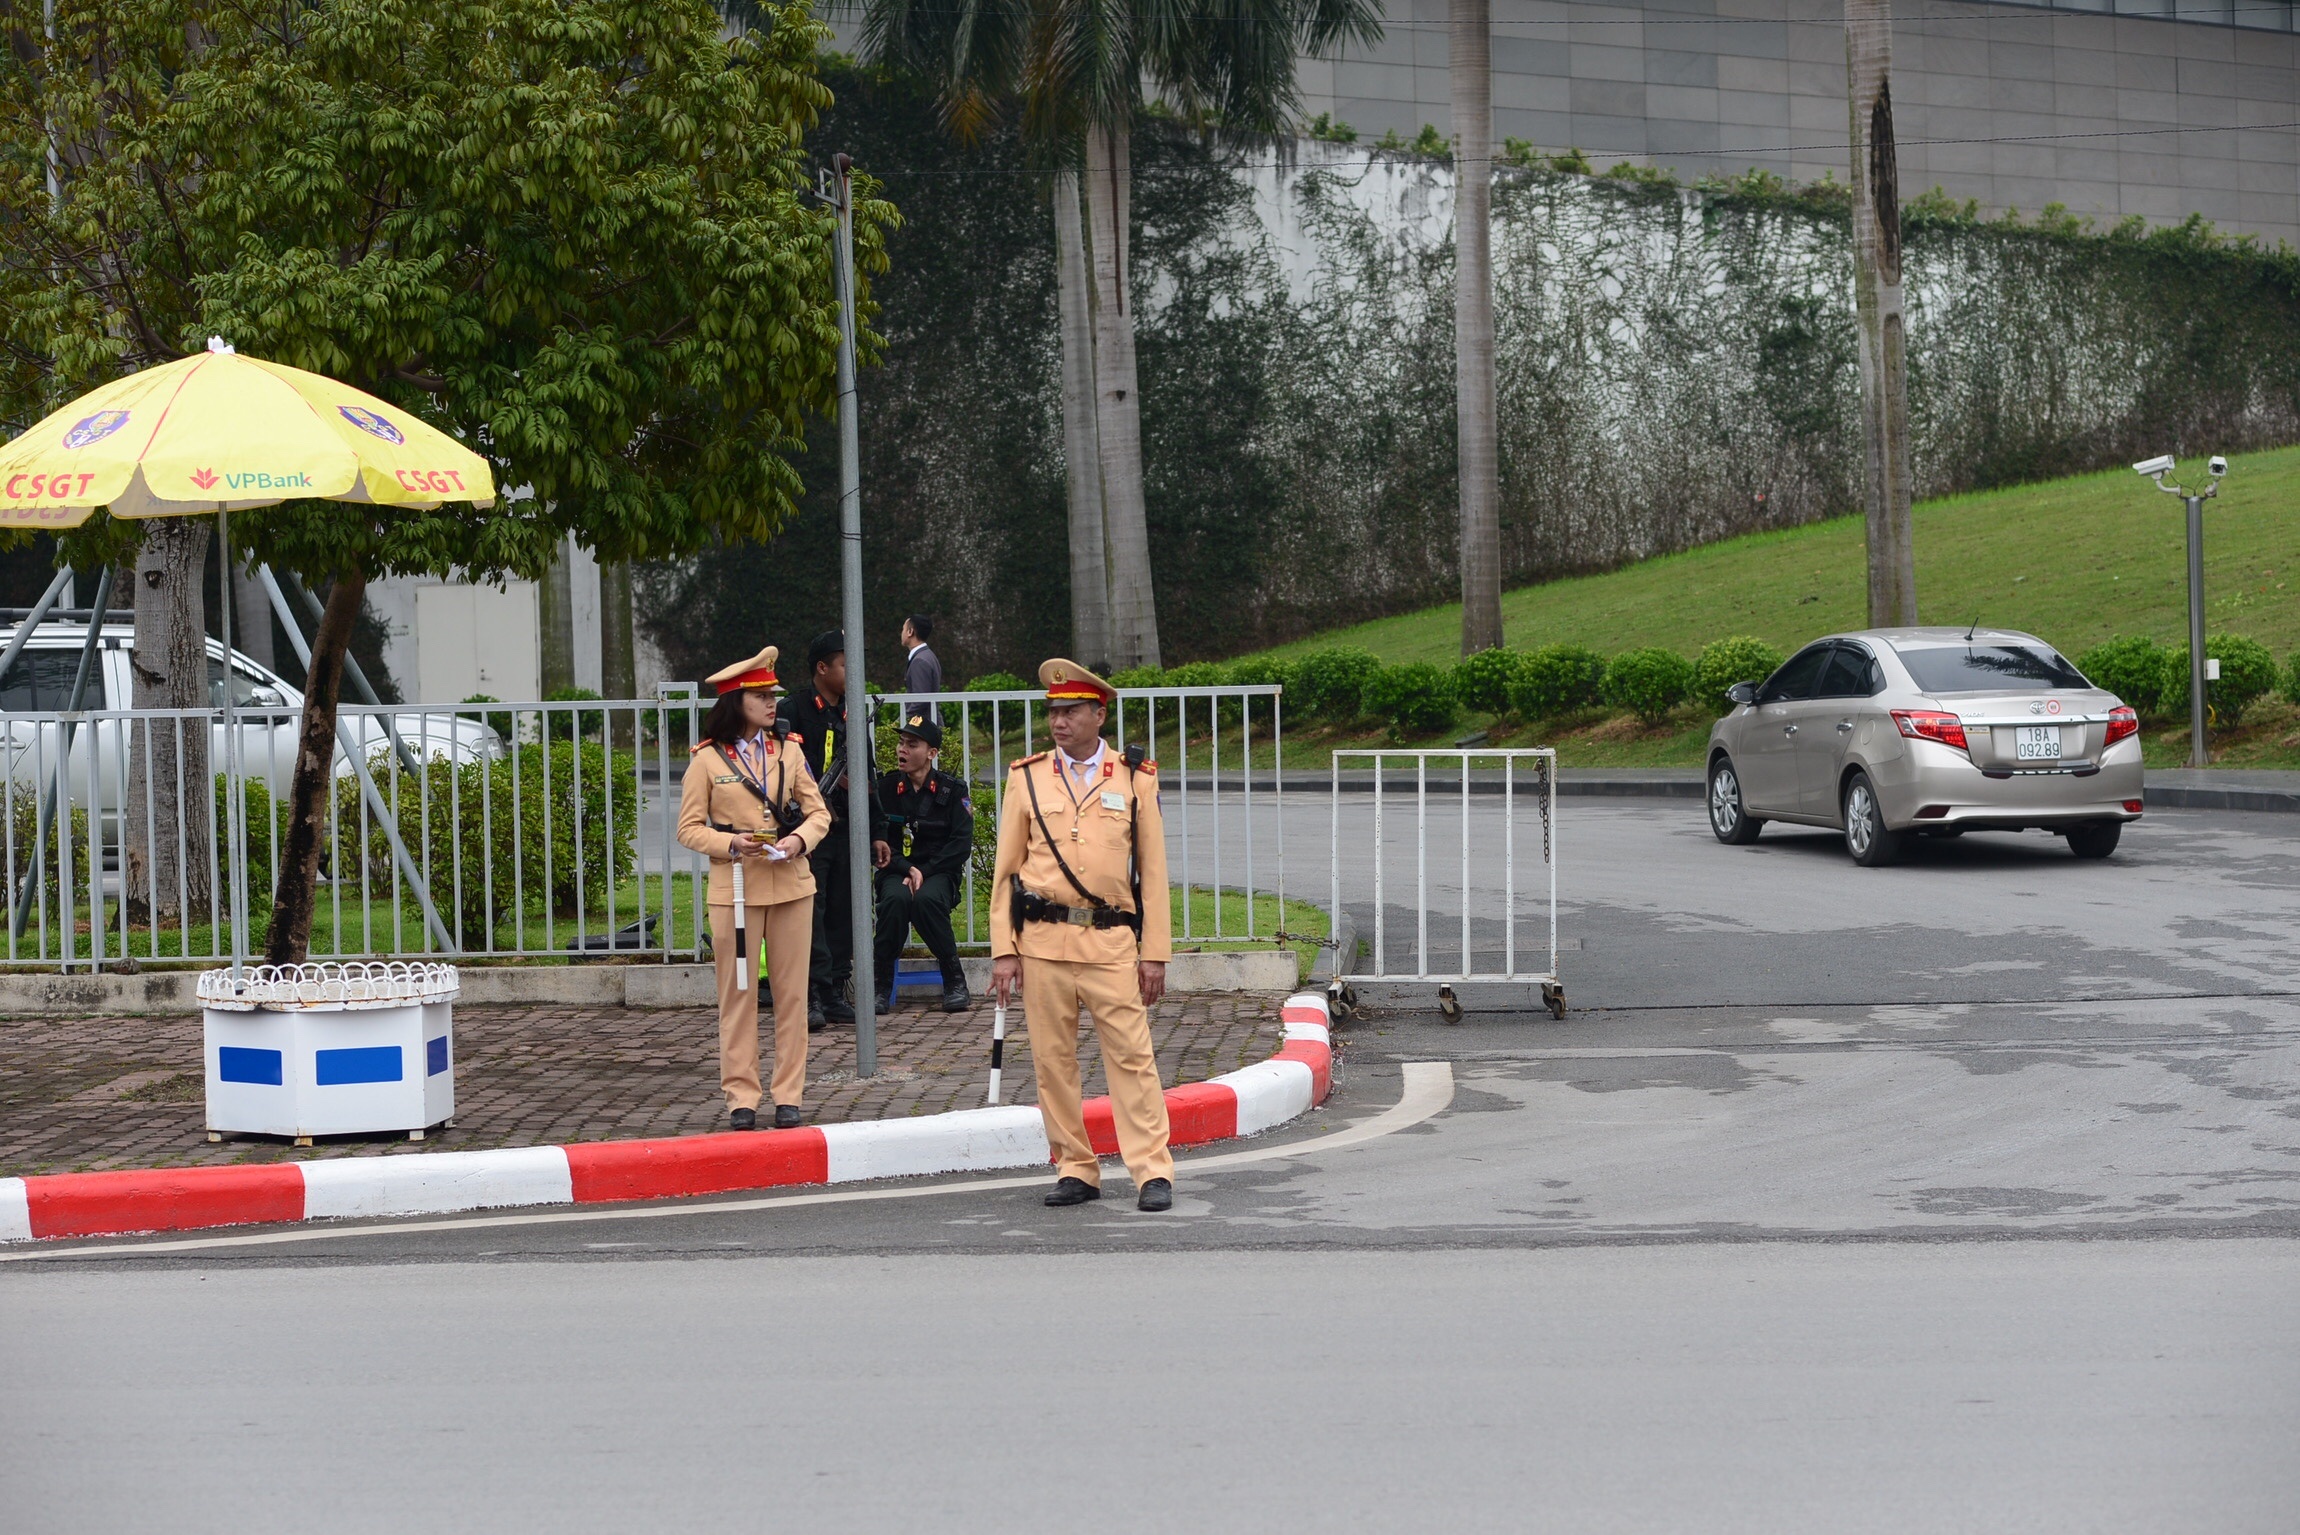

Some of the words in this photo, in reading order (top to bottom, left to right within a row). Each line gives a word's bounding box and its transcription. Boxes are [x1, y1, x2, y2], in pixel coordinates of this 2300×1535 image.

[6, 473, 95, 499] CSGT
[225, 472, 313, 489] VPBank
[395, 469, 466, 493] CSGT
[2028, 727, 2050, 742] 18A
[2019, 742, 2060, 757] 092.89
